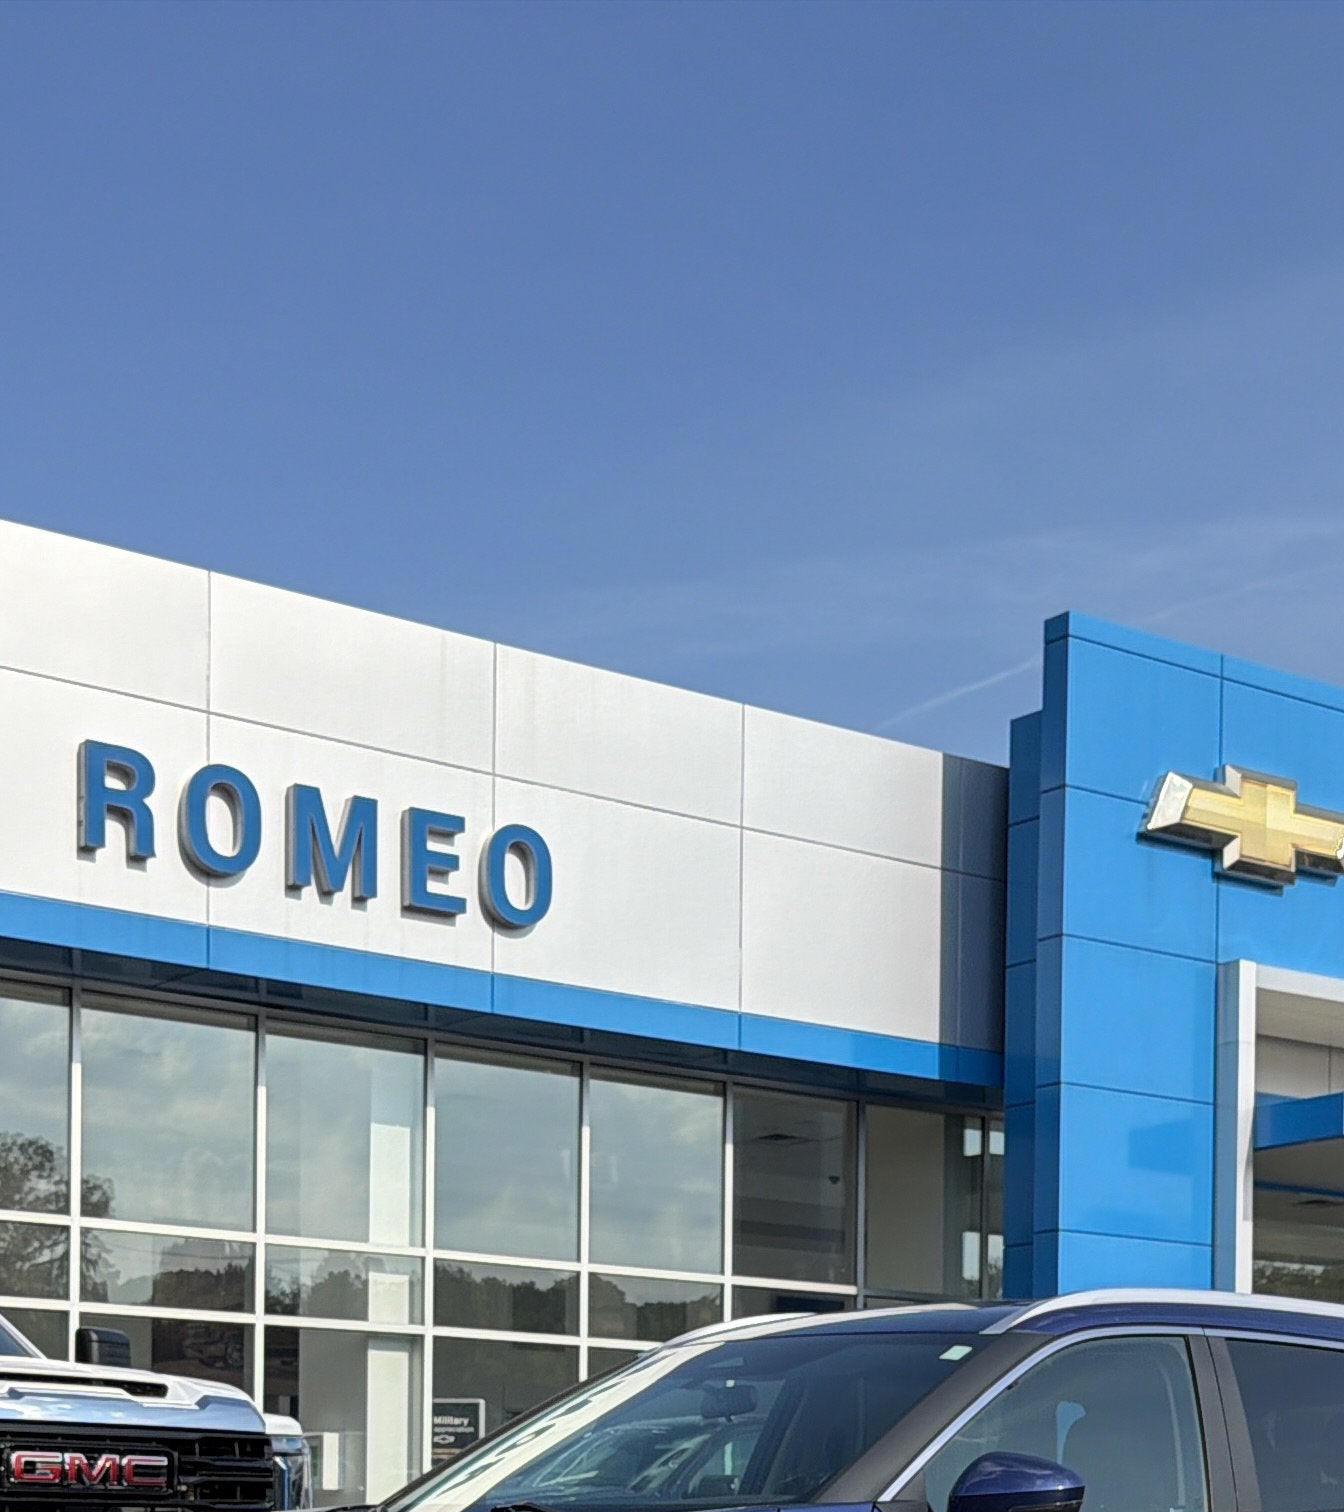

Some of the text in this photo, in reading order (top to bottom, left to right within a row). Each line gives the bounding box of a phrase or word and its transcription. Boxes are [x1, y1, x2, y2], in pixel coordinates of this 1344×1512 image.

[77, 739, 553, 929] ROMEO
[433, 1415, 470, 1427] Military
[10, 1450, 169, 1487] GMC
